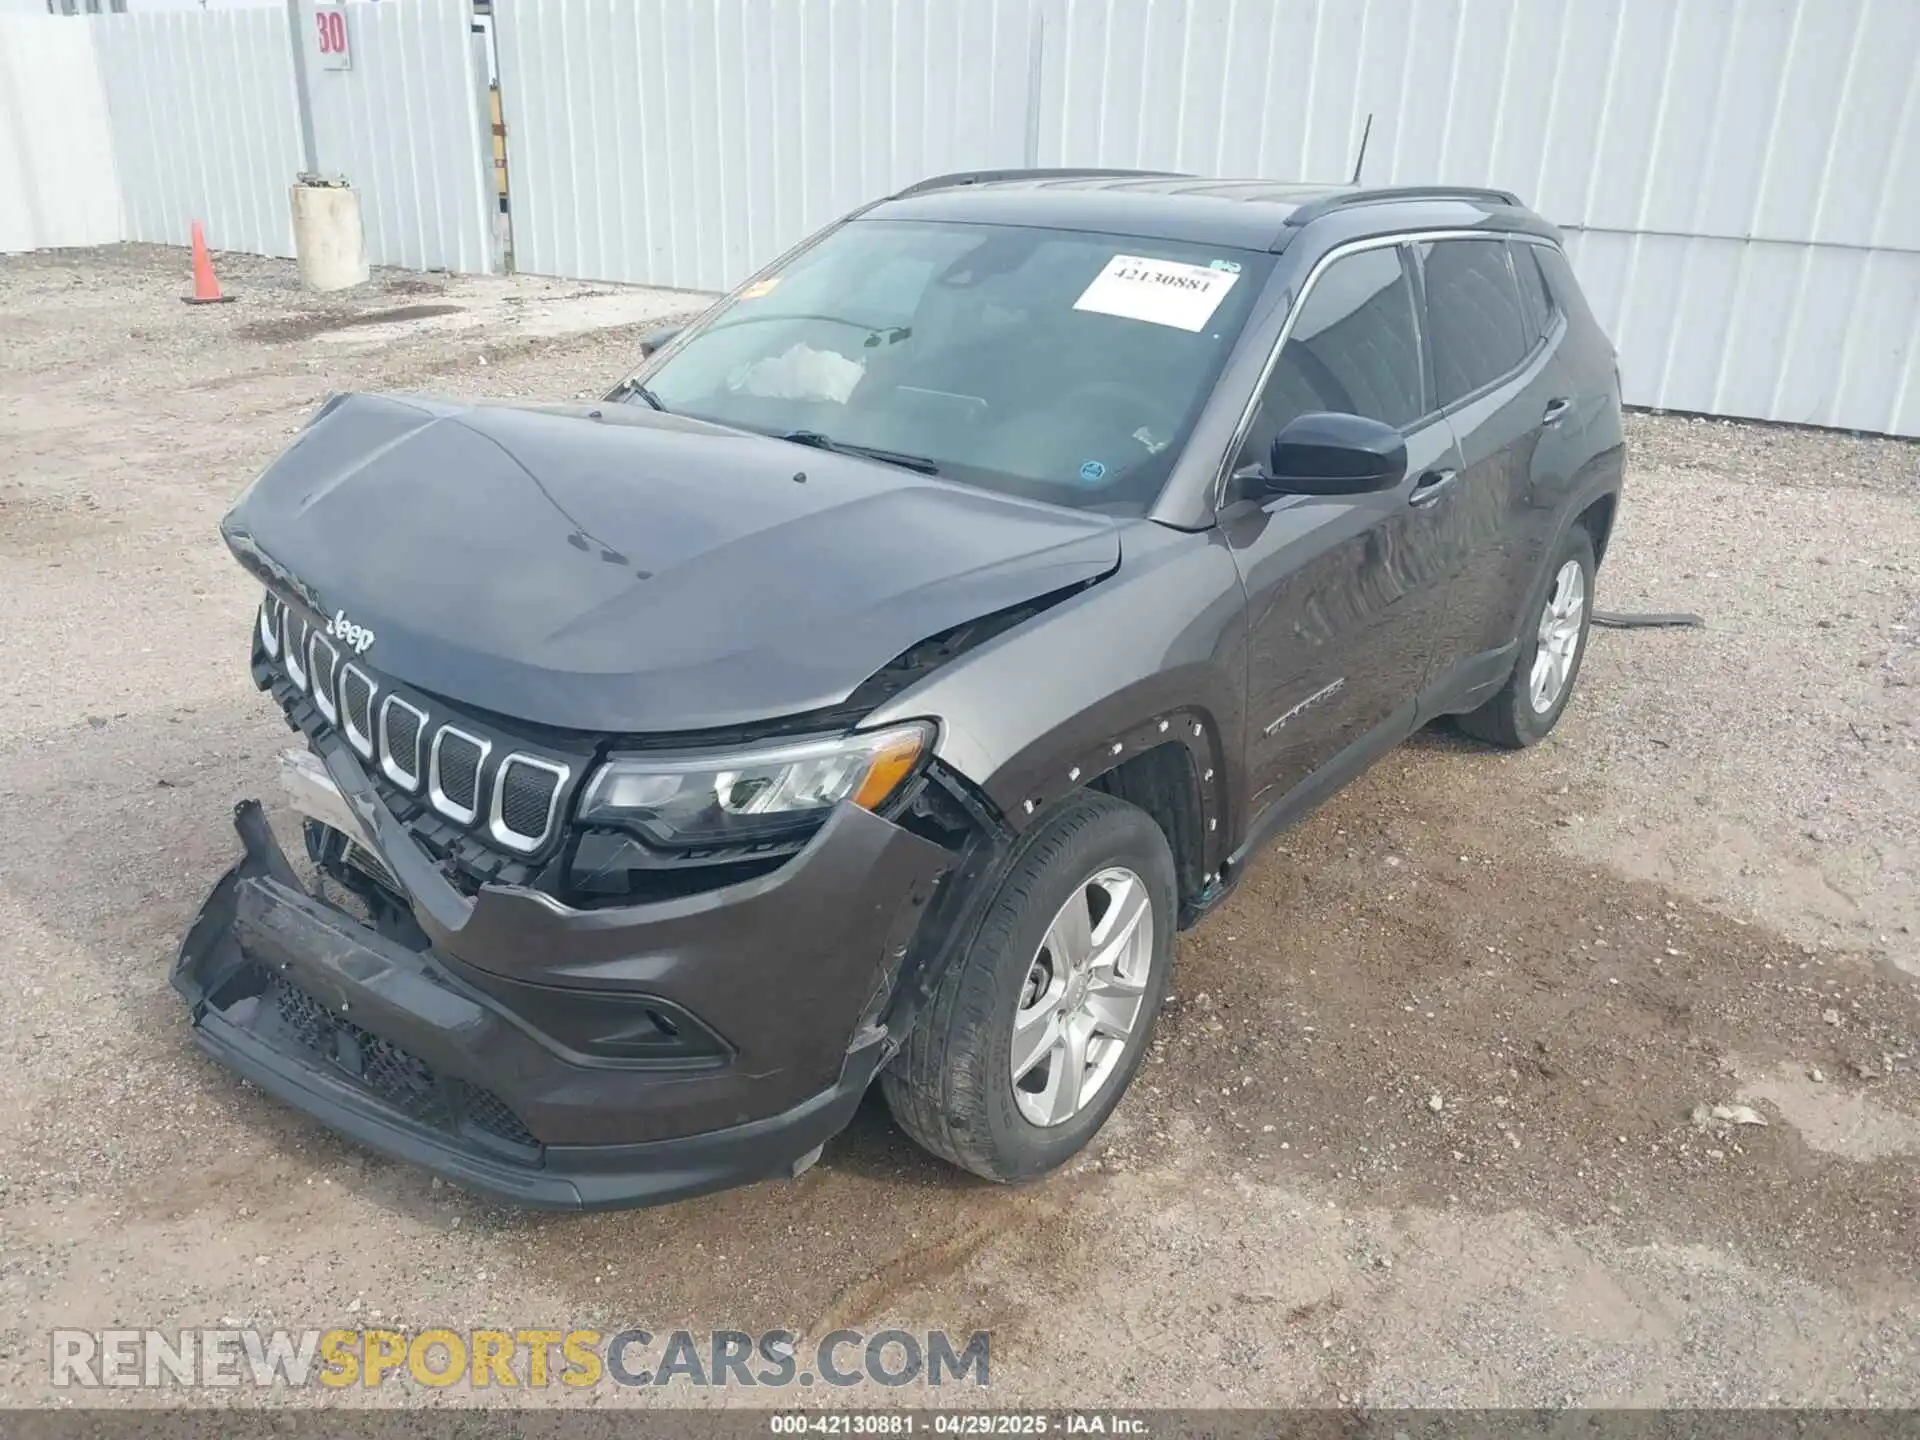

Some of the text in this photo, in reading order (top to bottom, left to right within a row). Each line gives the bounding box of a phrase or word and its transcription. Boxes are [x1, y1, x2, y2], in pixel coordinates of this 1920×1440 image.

[316, 12, 345, 53] 30
[1113, 267, 1212, 293] 42130881
[326, 610, 375, 654] Jeep
